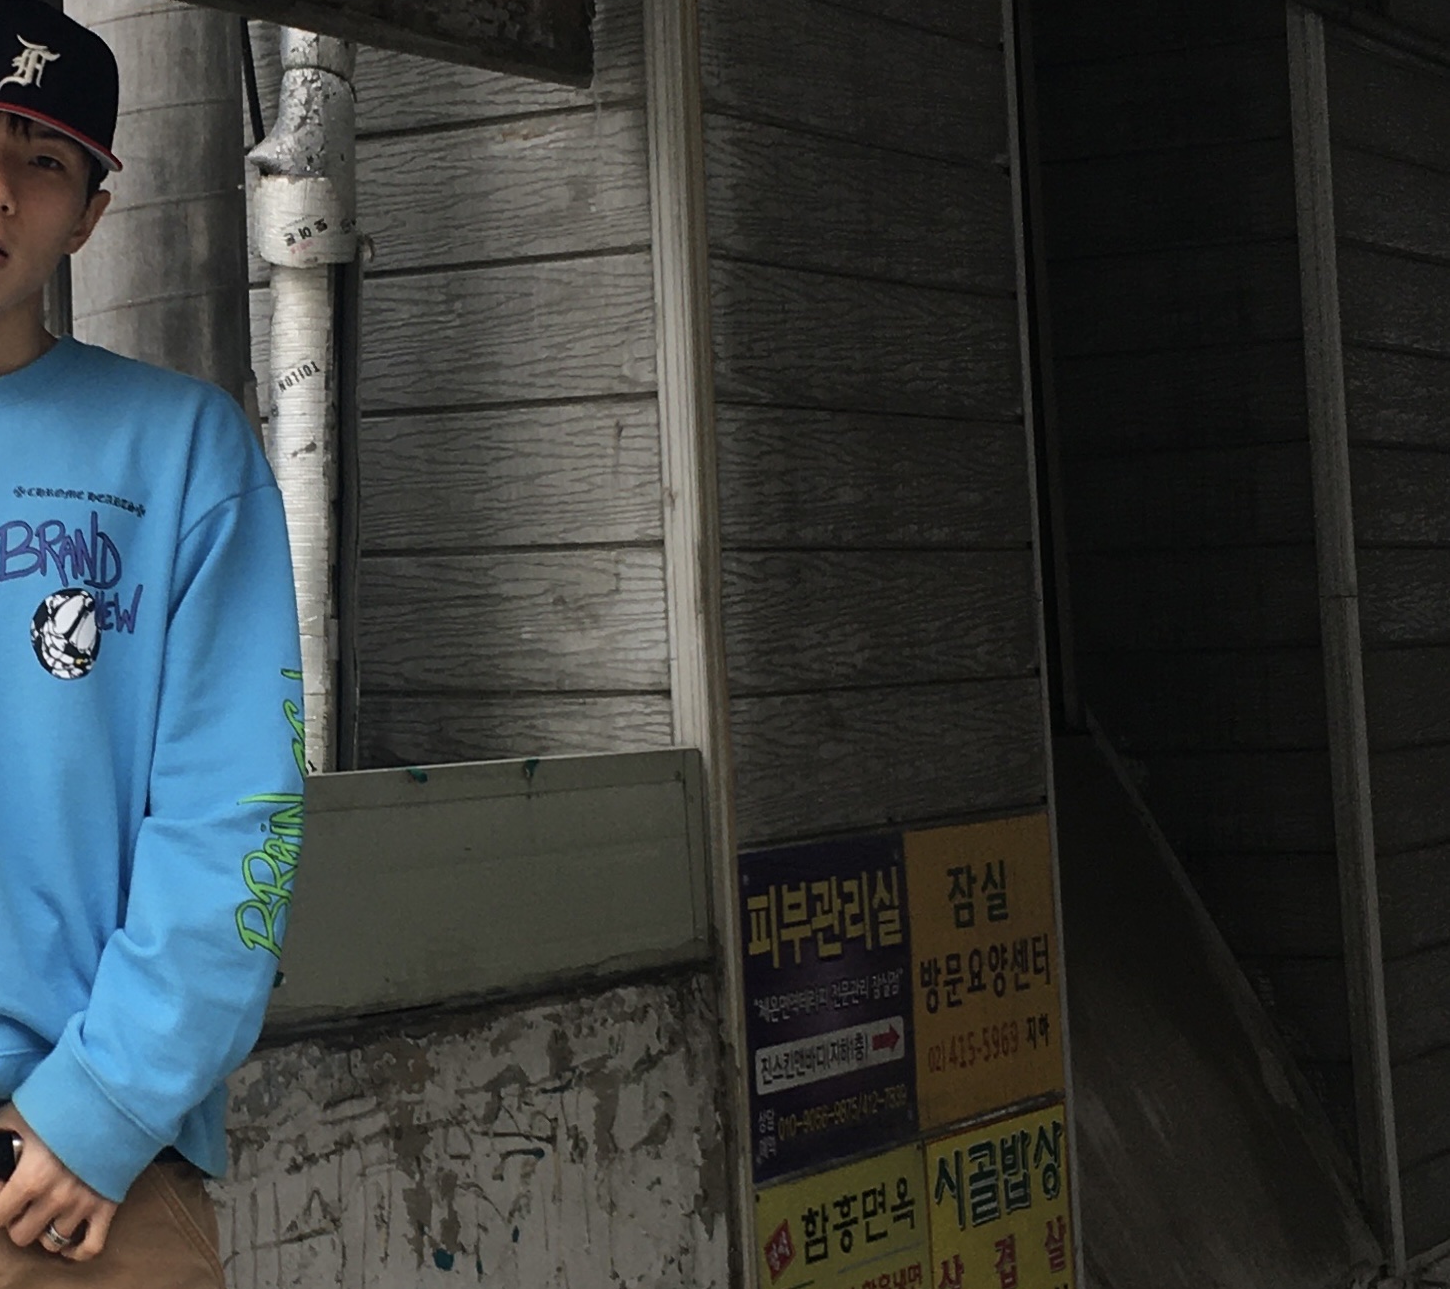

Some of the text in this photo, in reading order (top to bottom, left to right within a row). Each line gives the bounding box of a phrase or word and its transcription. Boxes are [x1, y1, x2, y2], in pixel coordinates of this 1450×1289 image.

[746, 865, 903, 969] 피부관리실
[946, 860, 1009, 929] 잠실
[919, 933, 1051, 1014] 방문요양센터
[934, 1120, 1063, 1230] 시골밥상
[801, 1177, 916, 1265] 함흥면옥
